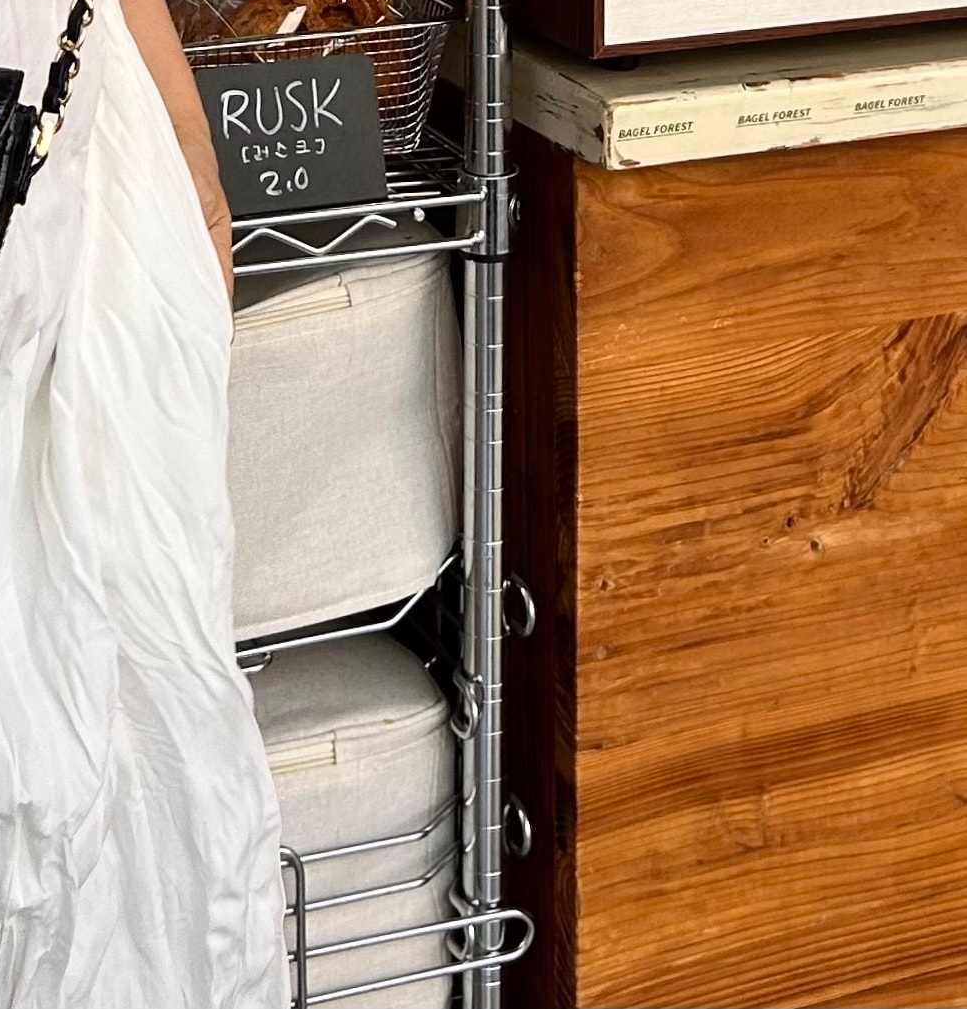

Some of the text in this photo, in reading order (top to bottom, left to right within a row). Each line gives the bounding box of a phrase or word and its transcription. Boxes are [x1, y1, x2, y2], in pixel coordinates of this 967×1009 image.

[220, 77, 344, 140] RUSK
[854, 94, 926, 112] BAGEL FOREST
[737, 107, 812, 124] BAGEL FOREST
[617, 120, 694, 140] BAGEL FOREST
[259, 166, 309, 196] 2.0
